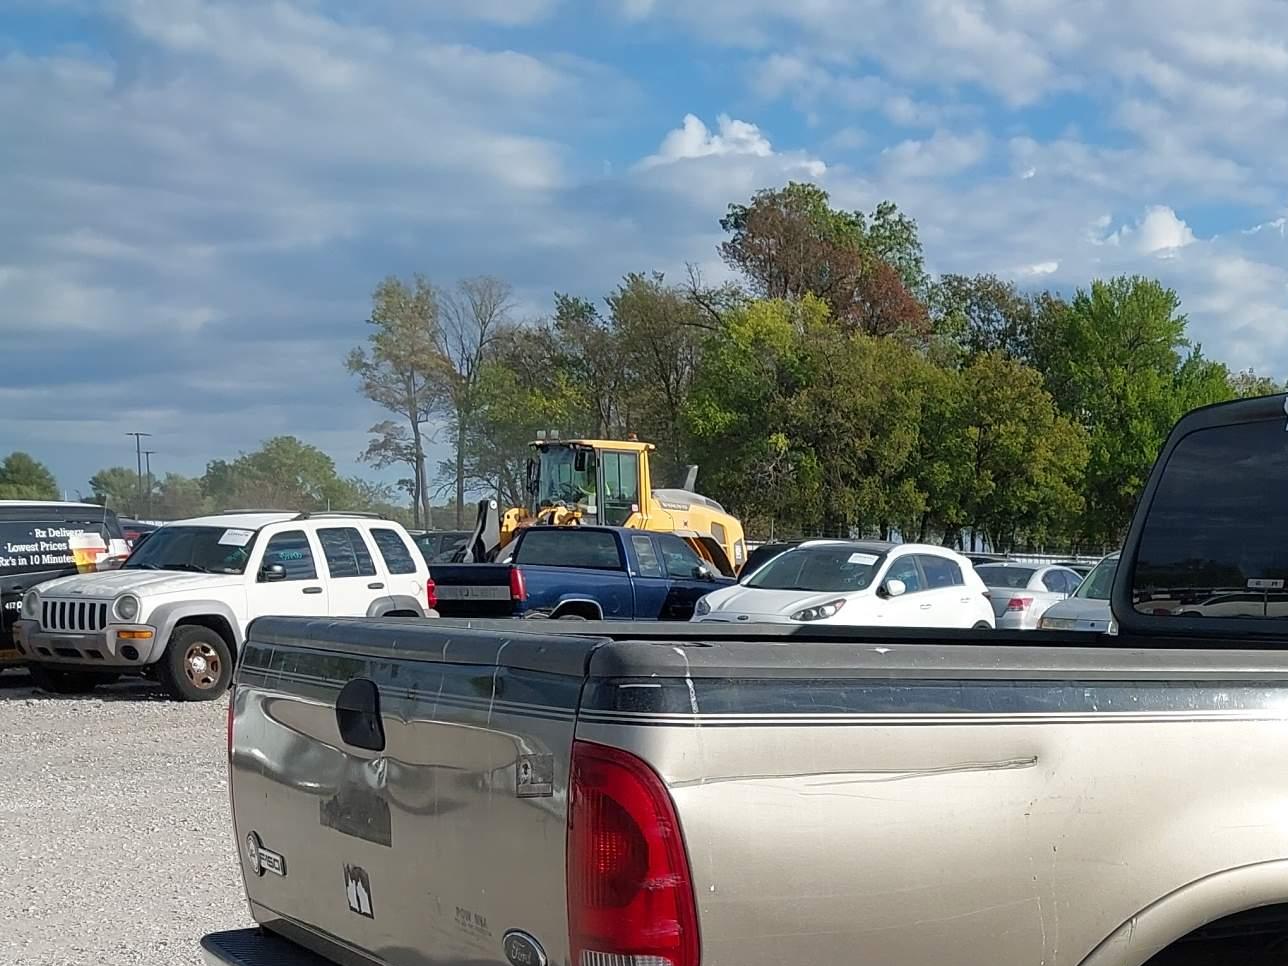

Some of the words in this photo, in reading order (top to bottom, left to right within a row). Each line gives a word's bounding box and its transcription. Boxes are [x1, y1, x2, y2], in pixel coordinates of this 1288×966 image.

[34, 529, 47, 538] Rx
[48, 528, 84, 537] Delivery
[7, 543, 39, 552] Lowest
[40, 541, 67, 551] Prices
[18, 556, 28, 565] in
[29, 555, 40, 564] 10
